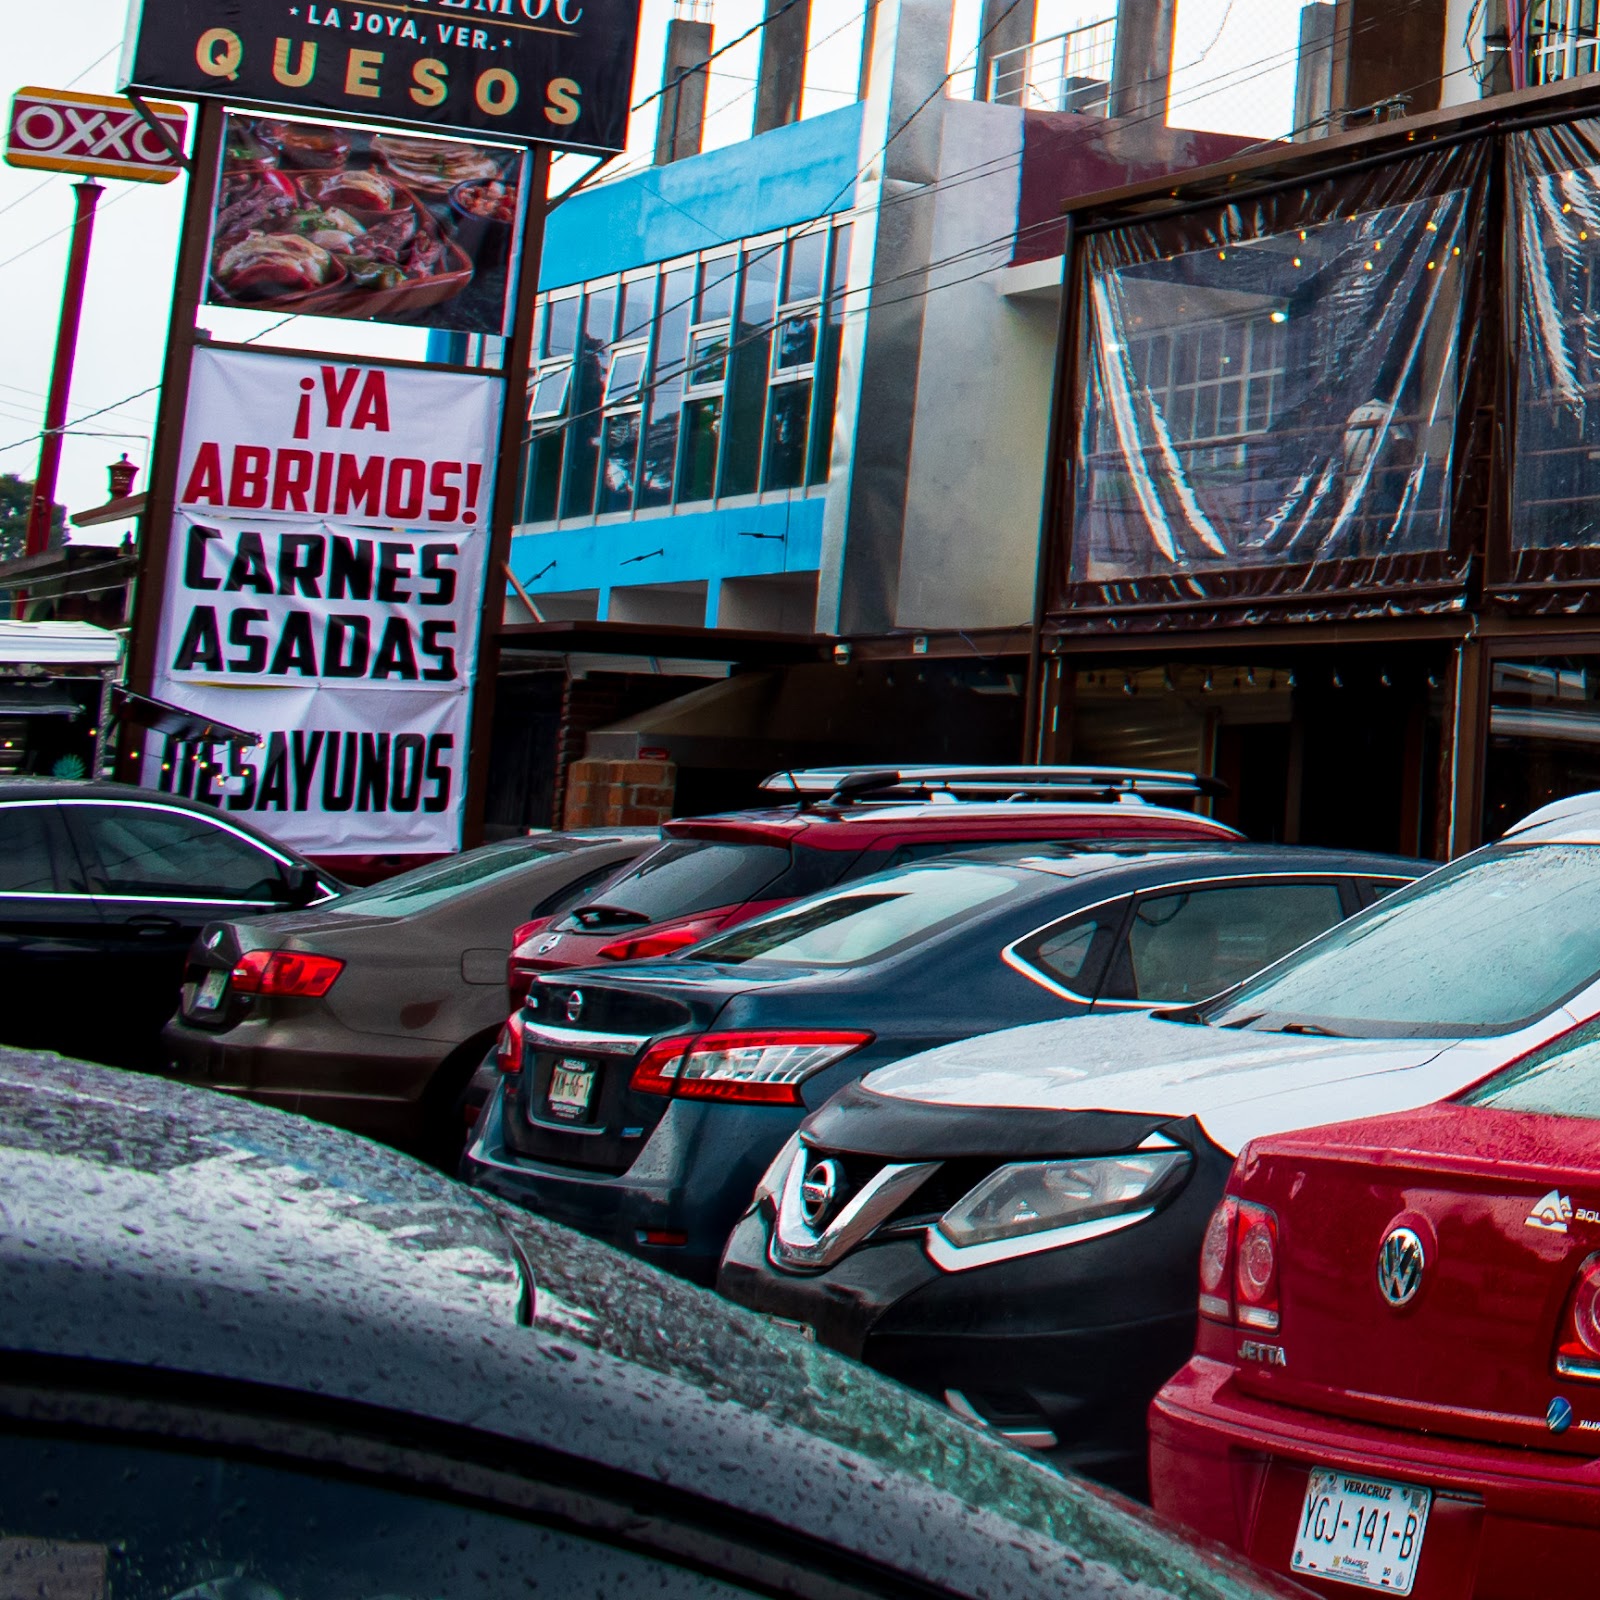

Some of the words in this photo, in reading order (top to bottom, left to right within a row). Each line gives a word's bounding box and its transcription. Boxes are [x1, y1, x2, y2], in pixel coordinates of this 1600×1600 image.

[307, 4, 342, 29] LA
[349, 10, 428, 45] JOYA,
[436, 22, 498, 52] VER.
[195, 26, 583, 126] QUESOS
[15, 104, 179, 162] OXXO
[292, 364, 390, 440] ¡YA
[182, 441, 483, 525] ABRIMOS!
[184, 524, 459, 606] CARNES
[173, 604, 459, 682] ASADAS
[1237, 1340, 1287, 1367] JETTA
[1343, 1478, 1393, 1502] VERACRUZ
[1302, 1493, 1419, 1561] YGJ-141-B
